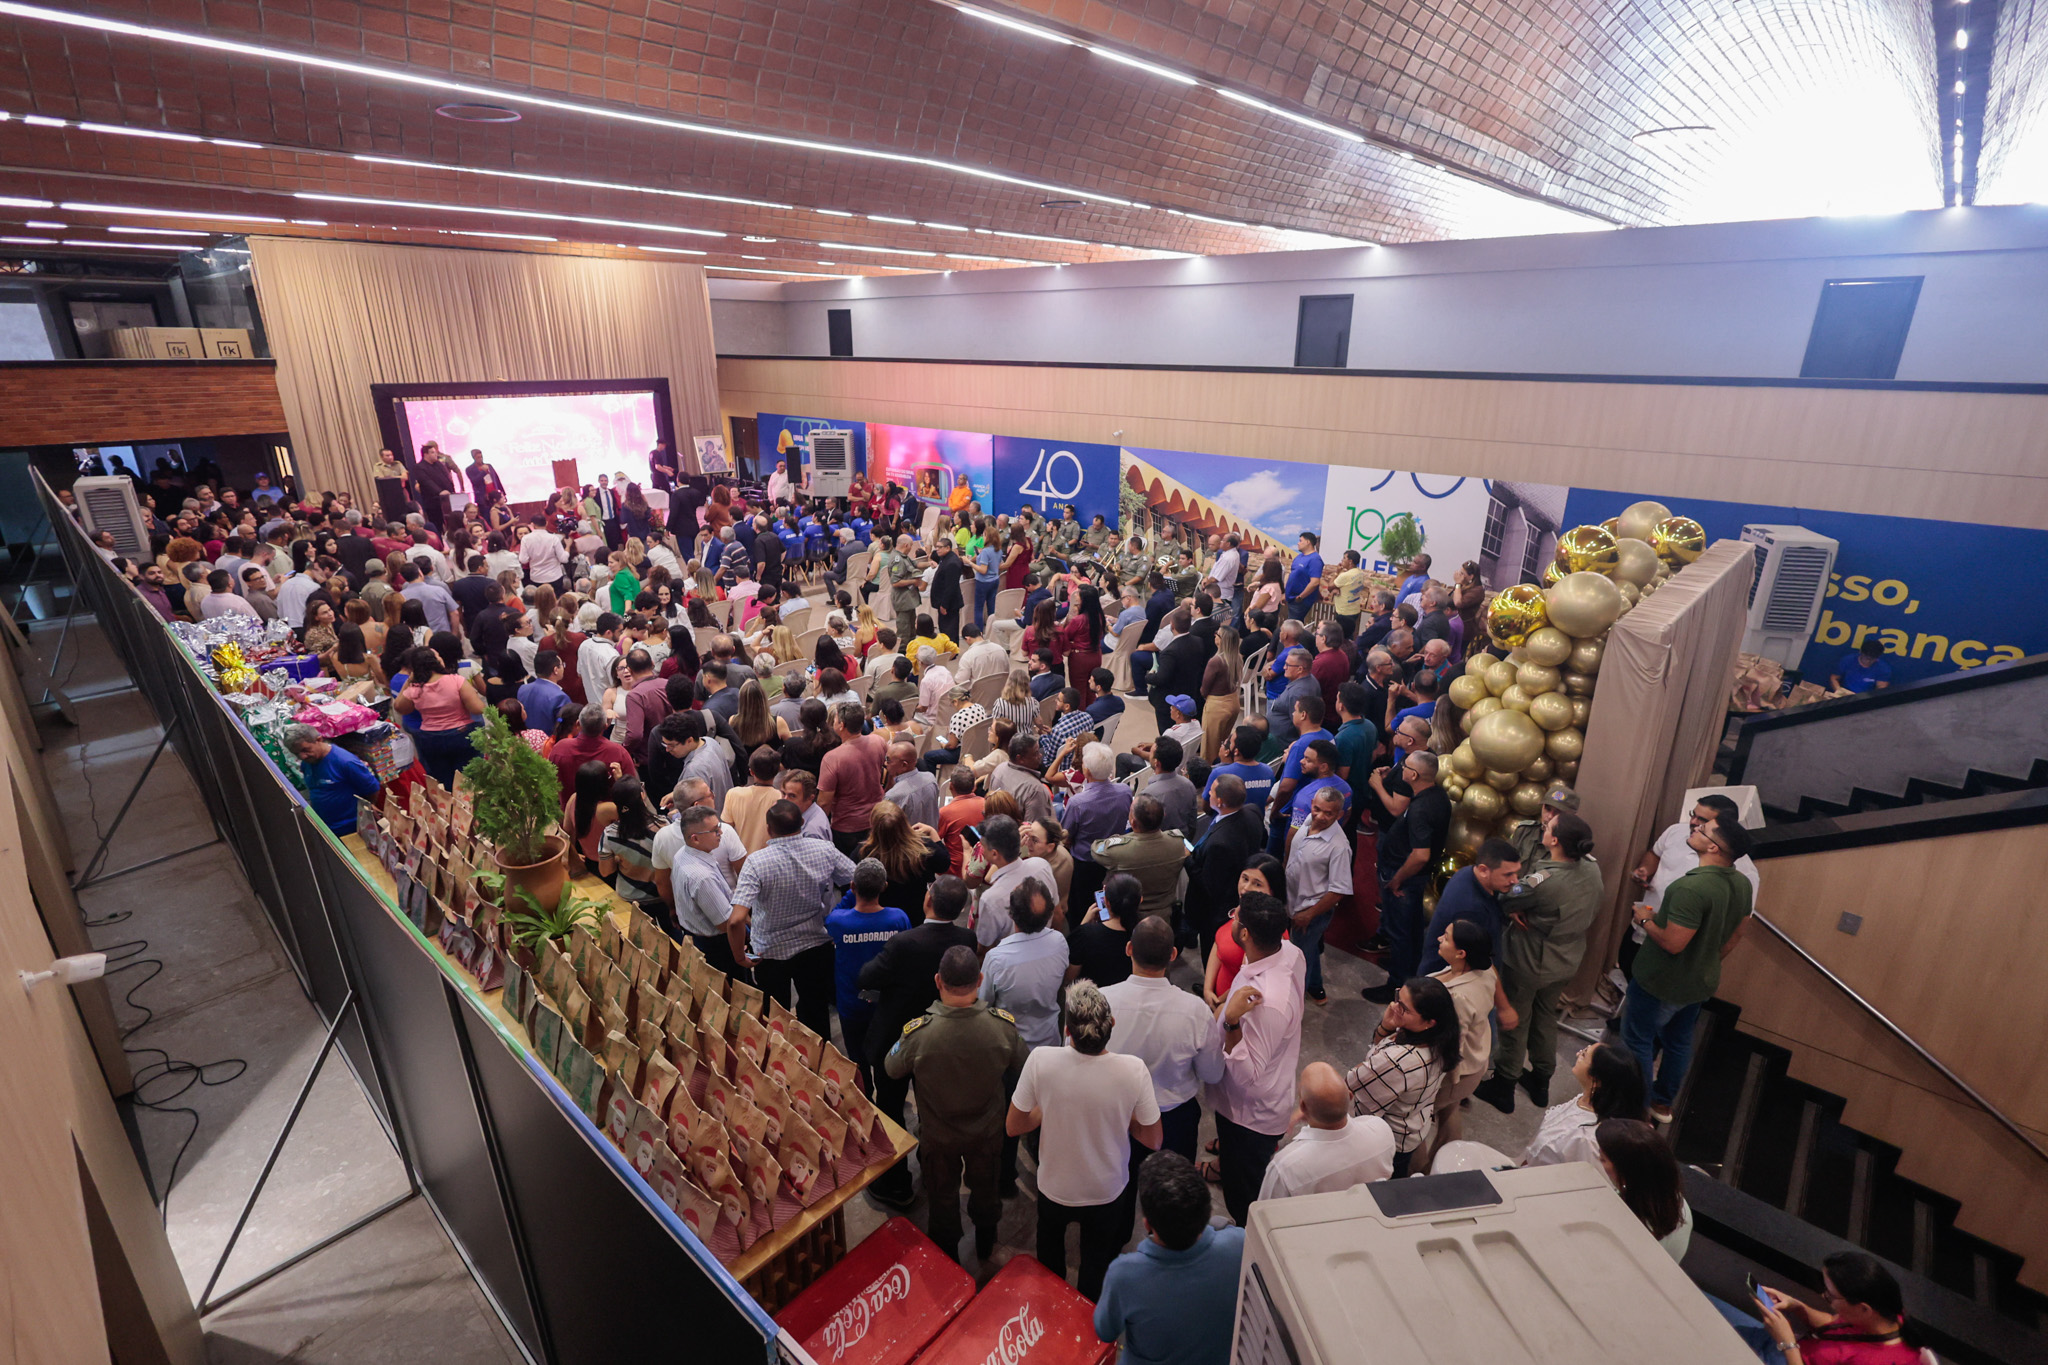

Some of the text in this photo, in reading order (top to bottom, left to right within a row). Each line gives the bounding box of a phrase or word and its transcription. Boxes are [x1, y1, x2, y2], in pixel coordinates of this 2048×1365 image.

[172, 346, 185, 355] fk
[223, 345, 236, 355] fk
[1018, 448, 1084, 512] 40
[842, 930, 899, 943] COLABORADO
